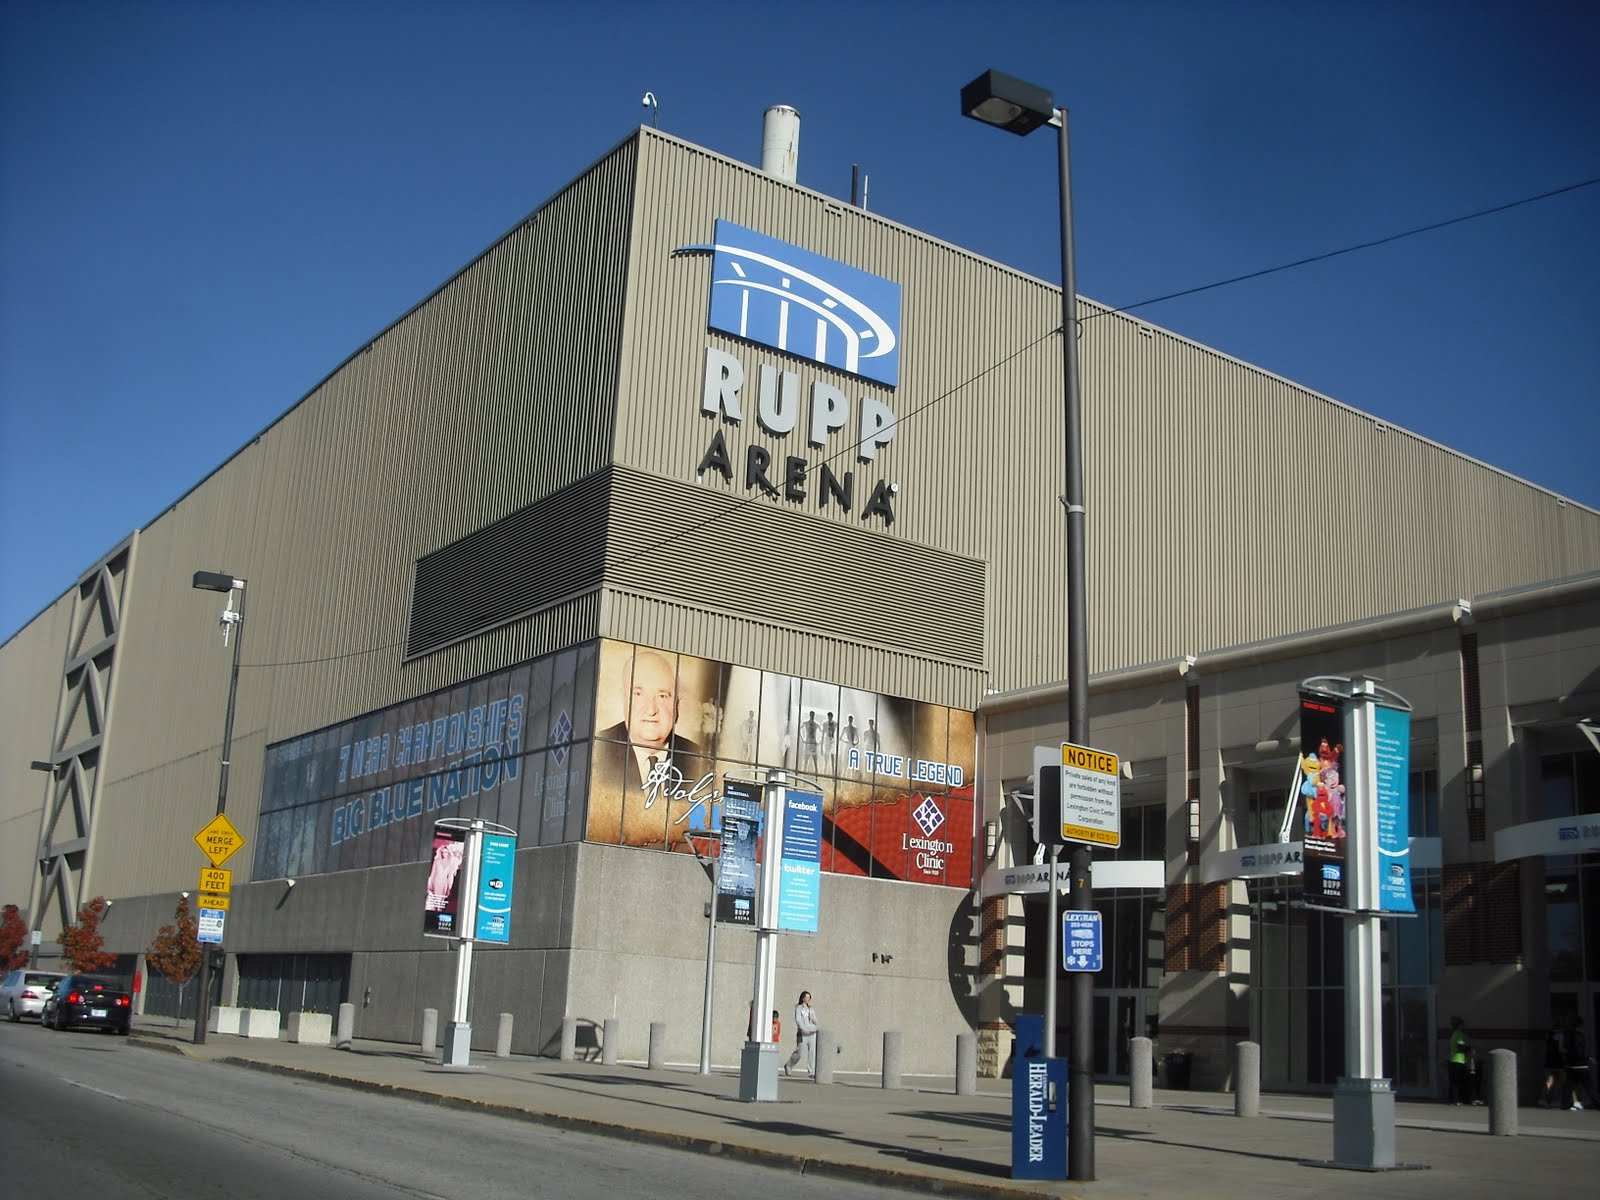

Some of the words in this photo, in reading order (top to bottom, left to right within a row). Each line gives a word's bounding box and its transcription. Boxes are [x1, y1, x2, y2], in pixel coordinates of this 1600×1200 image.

[700, 346, 897, 462] RUPP
[698, 429, 895, 526] ARENA
[339, 745, 351, 783] 7
[394, 694, 524, 768] CHAMPIONSHIPS
[1068, 749, 1112, 772] NOTICE
[848, 747, 860, 771] A
[865, 750, 903, 778] TRUE
[907, 758, 964, 787] LEGEND
[1065, 770, 1080, 779] Private
[331, 798, 365, 846] BIG
[368, 777, 423, 832] BLUE
[427, 737, 520, 812] NATION
[1077, 783, 1097, 792] forbidden
[1098, 788, 1114, 796] without
[1071, 794, 1093, 802] permission
[788, 800, 818, 812] facebook
[1067, 803, 1088, 812] Lexington
[1090, 806, 1100, 814] Civic
[1101, 808, 1115, 816] Center
[207, 836, 233, 846] MERGE
[902, 833, 953, 856] Lexington
[209, 847, 228, 856] LEFT
[916, 852, 944, 870] Clinic
[784, 863, 816, 875] twitter
[1036, 867, 1070, 882] ARNA
[207, 872, 224, 881] 400
[205, 881, 225, 890] FEET
[1077, 878, 1085, 889] 7
[1323, 879, 1341, 890] RUPP
[1323, 889, 1341, 897] ARENA
[203, 898, 224, 907] AHEAD
[1071, 940, 1095, 948] STOPS
[1073, 948, 1093, 956] HERE
[1029, 1063, 1047, 1162] HERALD-LEADER
